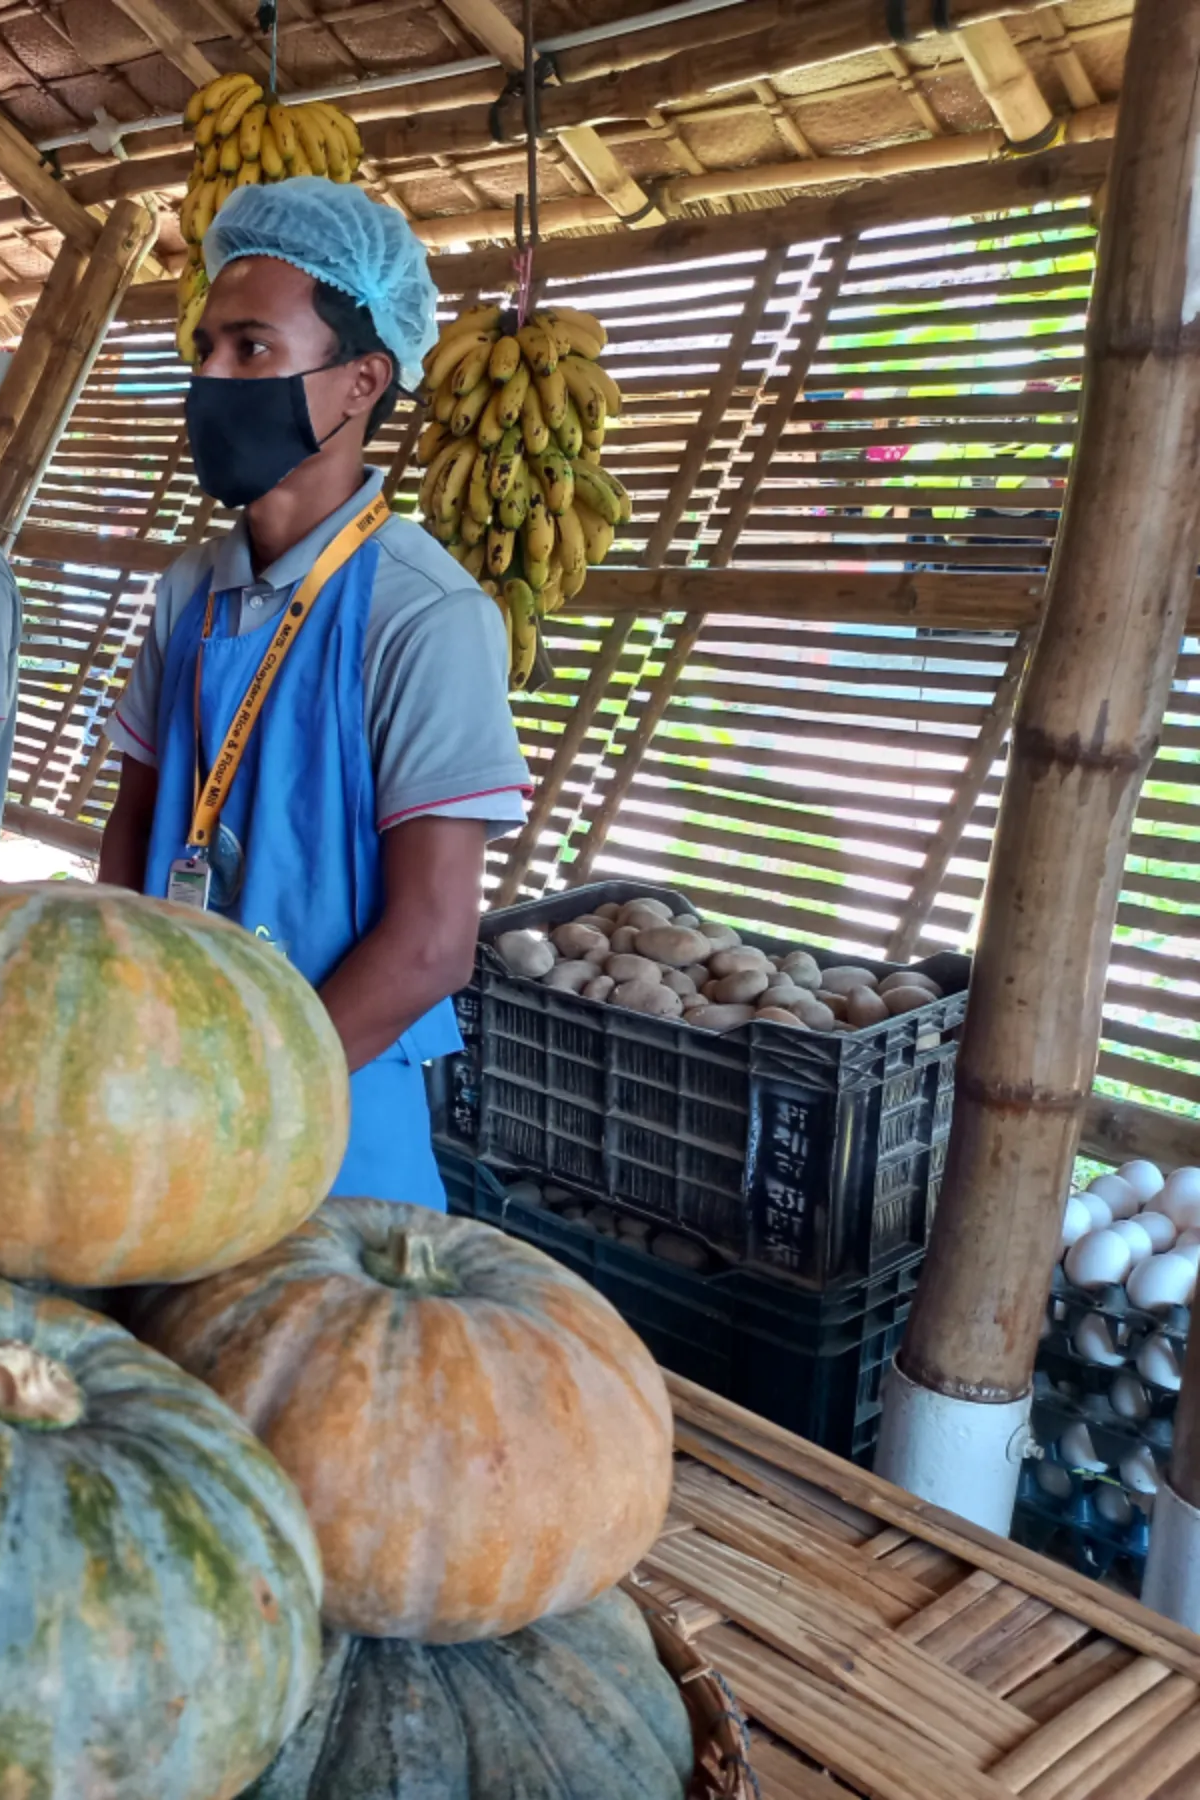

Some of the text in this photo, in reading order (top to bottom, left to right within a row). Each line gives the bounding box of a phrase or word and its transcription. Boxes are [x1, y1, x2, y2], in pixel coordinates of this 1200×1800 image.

[233, 709, 251, 738] Rice
[227, 739, 239, 750] &
[214, 751, 234, 784] Flour
[204, 786, 221, 808] Mill
